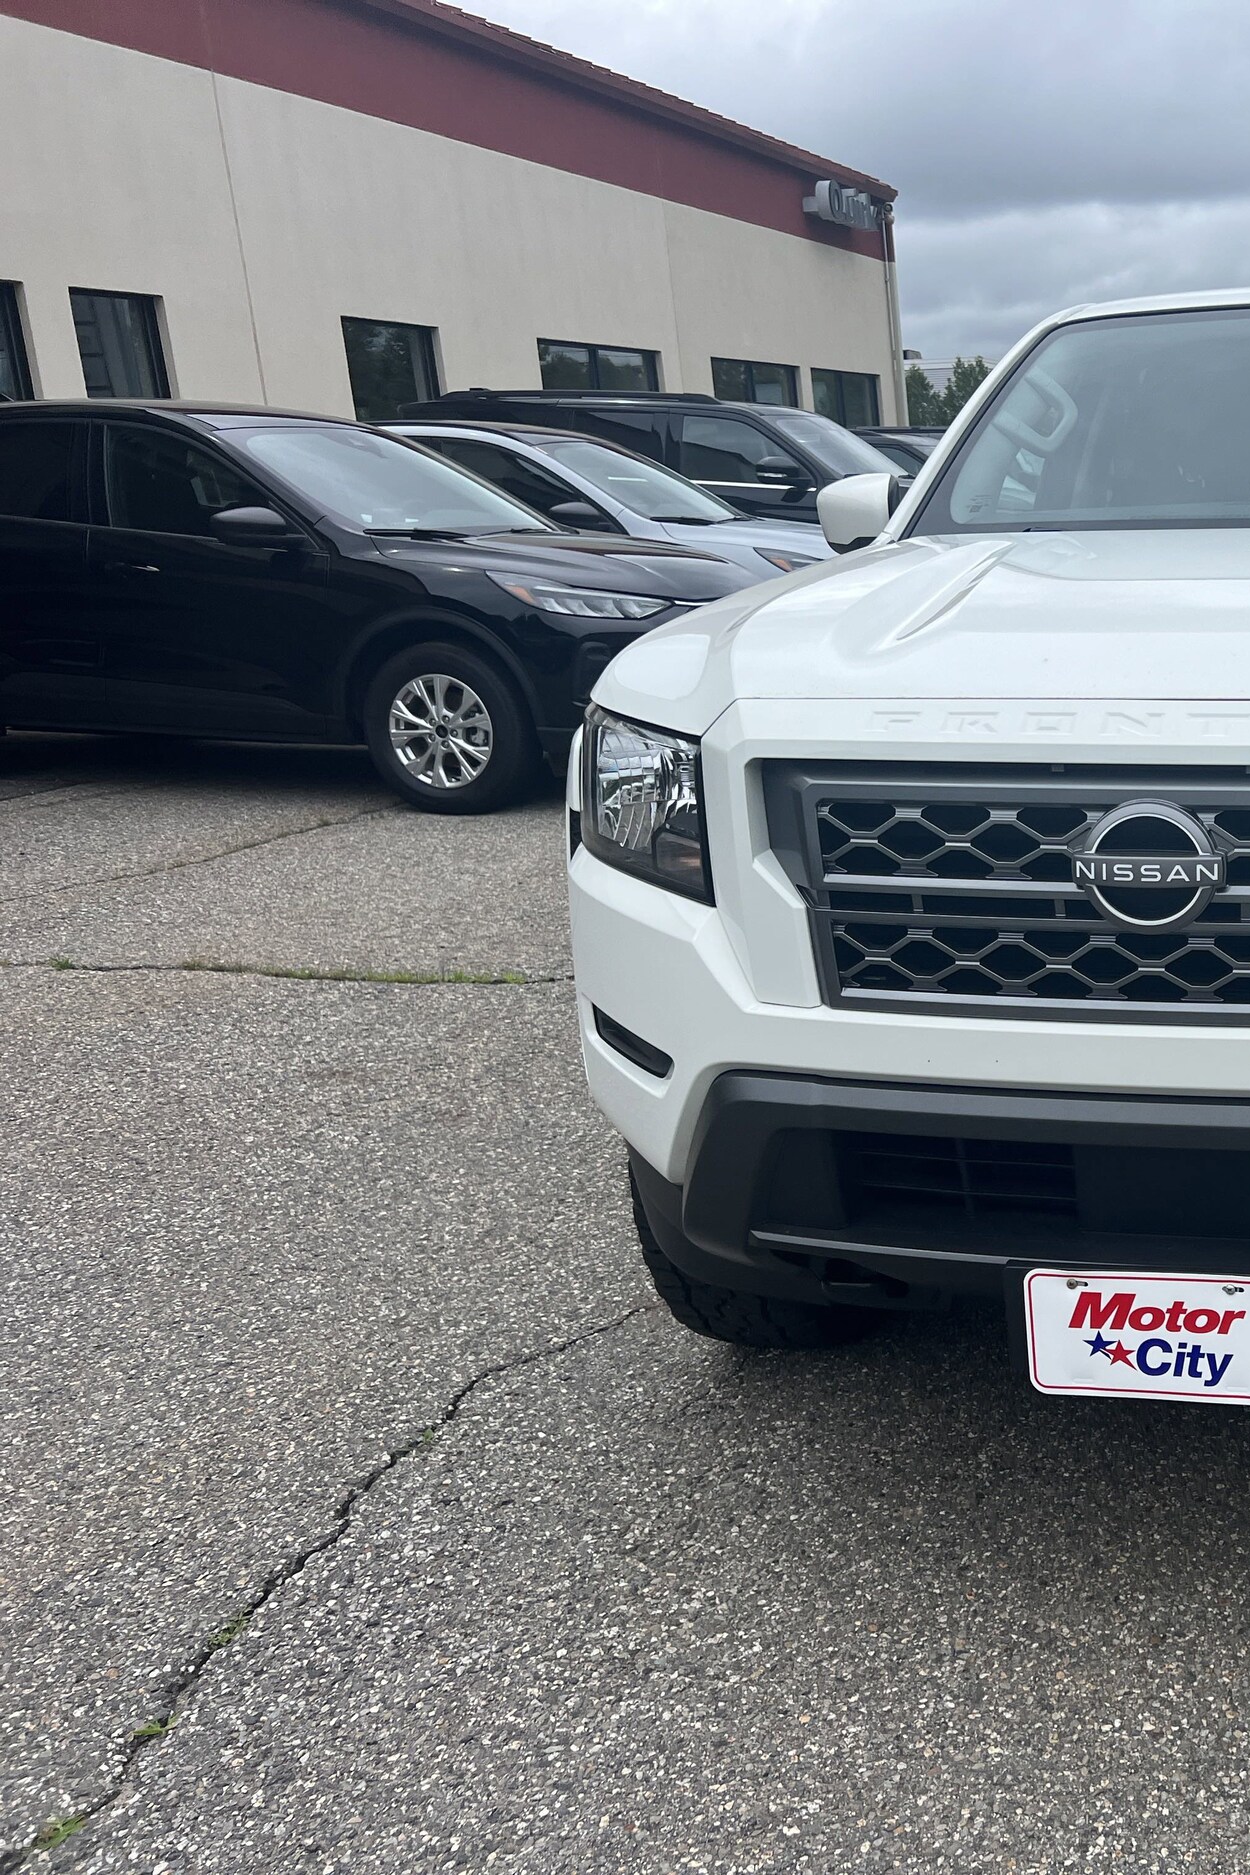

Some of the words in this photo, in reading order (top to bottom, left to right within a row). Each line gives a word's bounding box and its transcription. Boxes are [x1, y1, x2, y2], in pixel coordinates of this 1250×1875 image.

[1075, 861, 1219, 882] NISSAN
[1068, 1291, 1247, 1335] Motor
[1136, 1338, 1234, 1387] City
